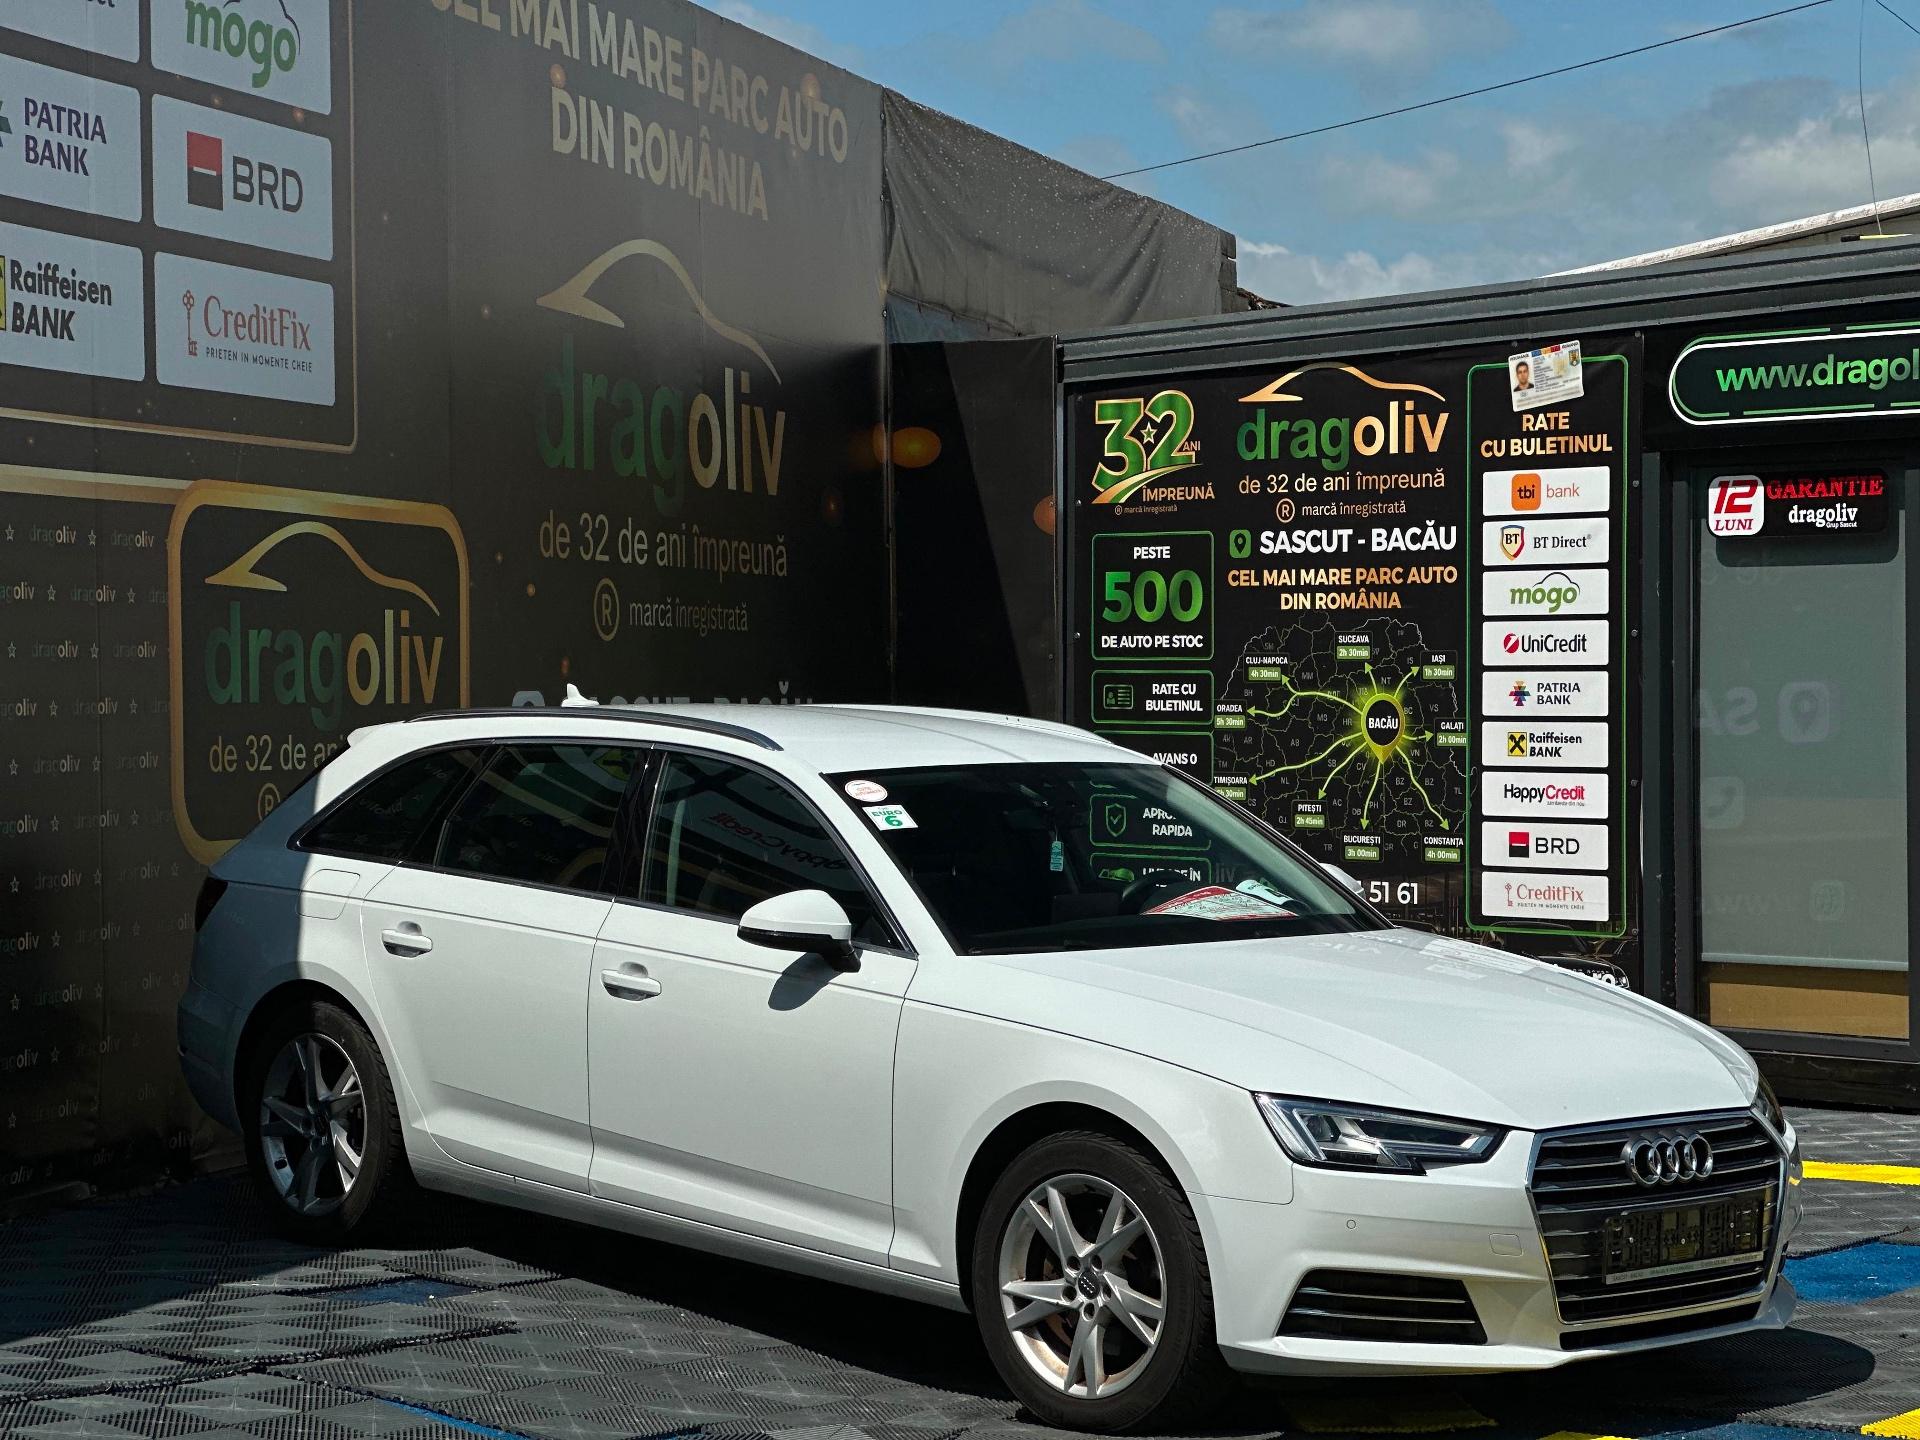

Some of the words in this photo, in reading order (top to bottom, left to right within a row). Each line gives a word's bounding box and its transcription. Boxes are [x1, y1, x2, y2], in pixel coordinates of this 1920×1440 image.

[185, 0, 297, 88] mogo
[588, 2, 684, 101] MARE
[691, 47, 768, 134] PARC
[775, 84, 848, 163] AUTO
[24, 97, 107, 144] PATRIA
[25, 134, 89, 176] BANK
[552, 86, 615, 169] DIN
[624, 111, 768, 220] ROMÂNIA
[232, 155, 303, 213] BRD
[10, 259, 112, 306] Raiffeisen
[11, 302, 75, 341] BANK
[203, 295, 311, 351] CreditFix
[206, 347, 238, 362] PRIETEN
[241, 352, 249, 363] IN
[252, 354, 289, 371] MOMENTE
[291, 360, 313, 373] CHEIE
[538, 333, 786, 517] dragoliv
[1522, 412, 1570, 431] RATE
[1092, 389, 1195, 492] 32
[1182, 441, 1201, 451] ANI
[1237, 400, 1450, 472] dragoliv
[1480, 439, 1505, 458] CU
[1510, 434, 1613, 456] BULETINUL
[1238, 475, 1261, 493] de
[1266, 474, 1288, 493] 32
[1294, 473, 1317, 492] de
[1323, 472, 1350, 491] ani
[1356, 468, 1445, 494] împreună
[1517, 484, 1535, 499] tbi
[1546, 483, 1580, 498] bank
[1766, 475, 1884, 499] GARANTIE
[1142, 482, 1216, 502] ÎMPREUNĂ
[1713, 480, 1759, 515] 12
[1302, 503, 1337, 516] marcă
[1339, 500, 1407, 518] înregistrată
[1788, 503, 1858, 527] dragoliv
[1713, 518, 1754, 532] LUNI
[540, 509, 570, 559] de
[579, 512, 610, 562] 32
[618, 517, 648, 564] de
[656, 523, 687, 568] ani
[692, 523, 788, 583] împreună
[1259, 529, 1353, 554] SASCUT
[1371, 520, 1457, 552] BACĂU
[1505, 534, 1519, 545] BT
[1533, 537, 1548, 549] BT
[1133, 546, 1171, 559] PESTE
[1227, 569, 1259, 587] CEL
[1263, 569, 1296, 586] MAI
[1300, 568, 1351, 585] MARE
[1355, 567, 1404, 584] PARC
[1407, 566, 1458, 584] AUTO
[1102, 569, 1204, 622] 500
[1280, 593, 1311, 609] DIN
[1315, 588, 1402, 609] ROMÂNIA
[1510, 586, 1578, 613] mogo
[629, 599, 673, 628] marcă
[675, 598, 748, 638] înregistrată
[1101, 636, 1118, 648] DE
[1119, 635, 1152, 648] AUTO
[1154, 635, 1171, 648] PE
[1172, 635, 1204, 648] STOC
[1338, 635, 1369, 643] SUCEAVA
[1521, 633, 1587, 652] UniCredit
[205, 601, 443, 731] dragoliv
[1245, 656, 1288, 665] CLUJ-NAPOCA
[1152, 684, 1179, 695] RATE
[1181, 683, 1196, 695] CU
[1537, 682, 1581, 693] PATRIA
[1145, 700, 1204, 711] BULETINUL
[1216, 704, 1243, 713] ORADEA
[1537, 695, 1571, 705] BANK
[1368, 715, 1399, 729] BACĂU
[1529, 732, 1582, 744] Raiffeisen
[209, 736, 237, 772] de
[246, 735, 272, 771] 32
[280, 735, 306, 770] de
[1529, 747, 1562, 757] BANK
[1504, 783, 1585, 803] HappyCredit
[884, 816, 903, 827] 6
[1152, 824, 1193, 837] RAPIDA
[1347, 849, 1356, 857] 3h
[1427, 851, 1436, 859] 4h
[1535, 837, 1580, 854] BRD
[1369, 881, 1390, 903] 51
[1396, 882, 1418, 904] 61
[1516, 883, 1584, 902] CreditFix
